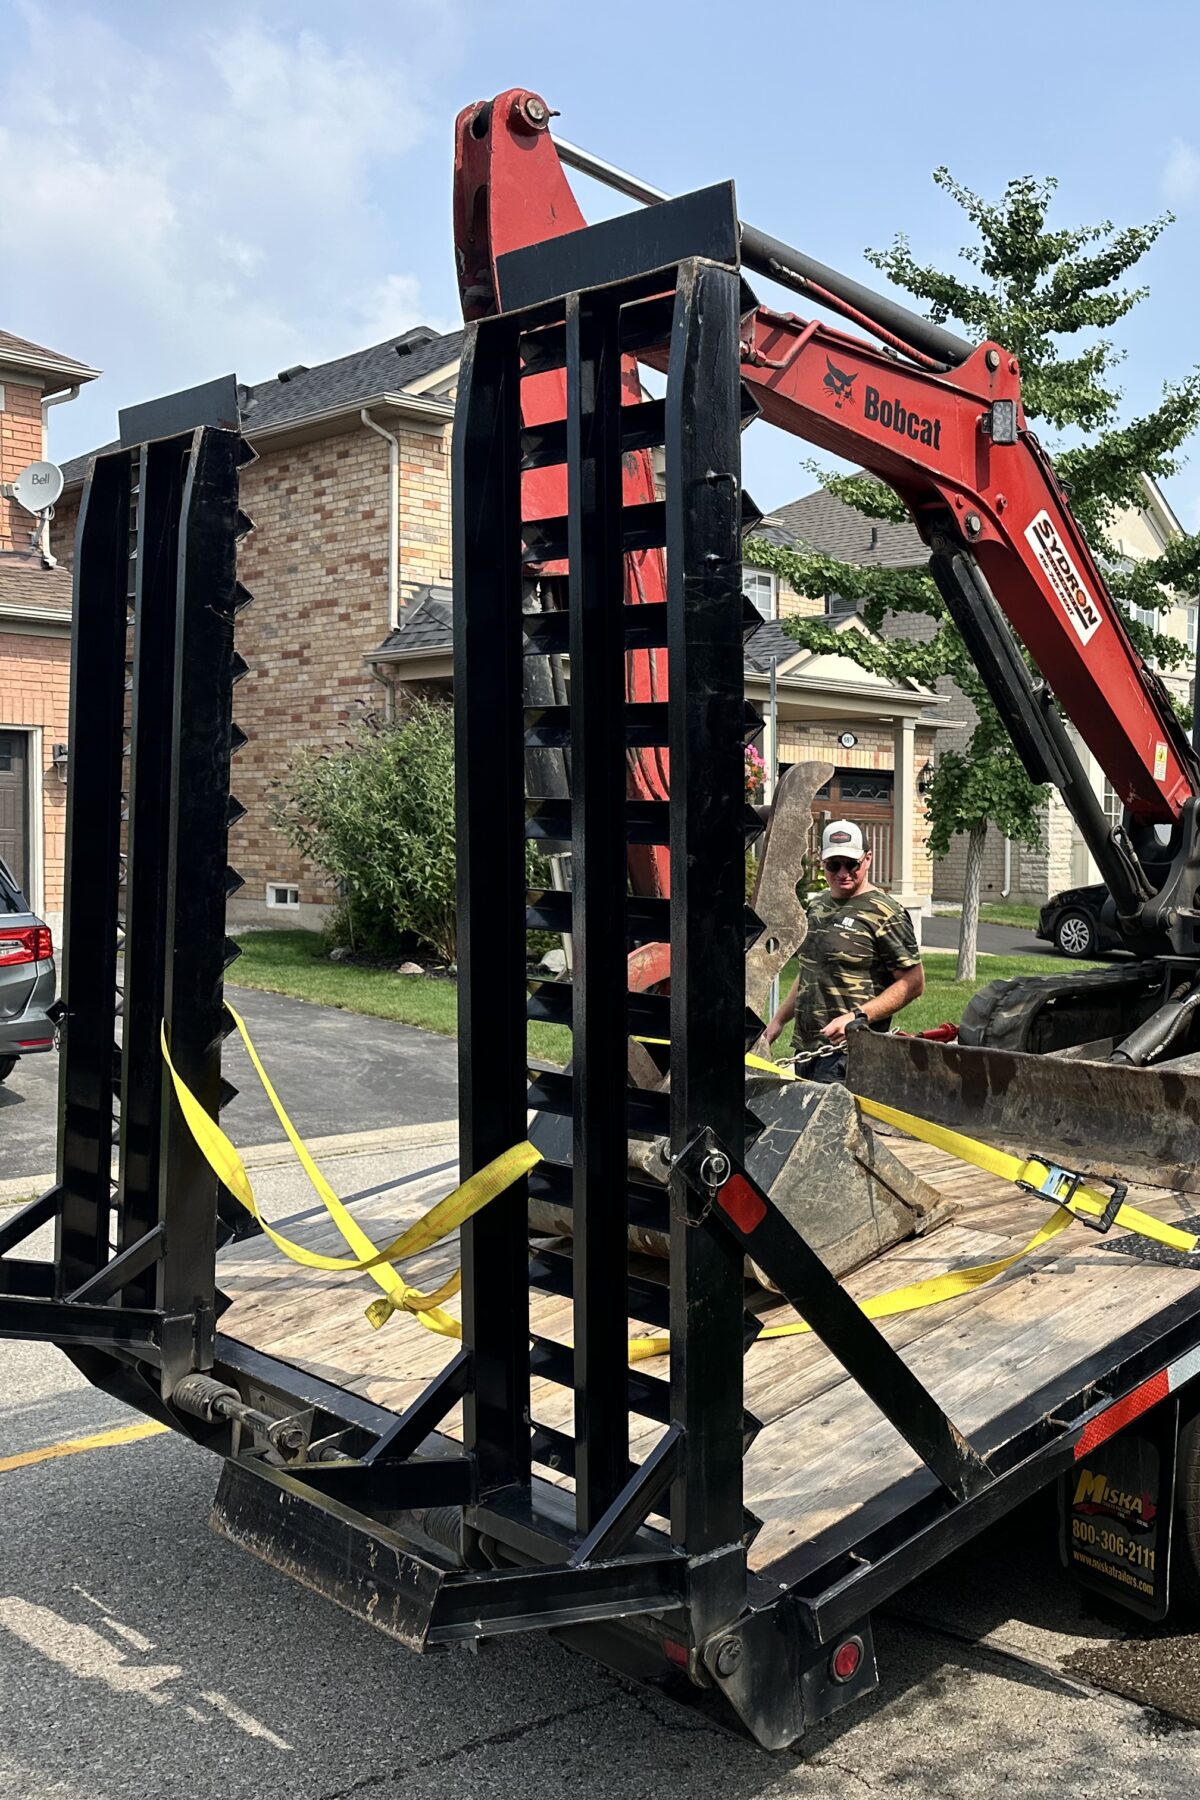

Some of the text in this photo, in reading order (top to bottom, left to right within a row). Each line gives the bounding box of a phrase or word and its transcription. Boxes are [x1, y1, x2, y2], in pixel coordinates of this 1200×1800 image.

[864, 385, 941, 451] Bobcat
[32, 473, 50, 485] Bell
[1038, 518, 1098, 626] SYDRON
[1038, 552, 1075, 616] 416-745-RENT
[1072, 1468, 1144, 1514] MISKA
[1072, 1518, 1155, 1571] 800-306-2111
[1073, 1549, 1154, 1596] www.miskatrailers.com
